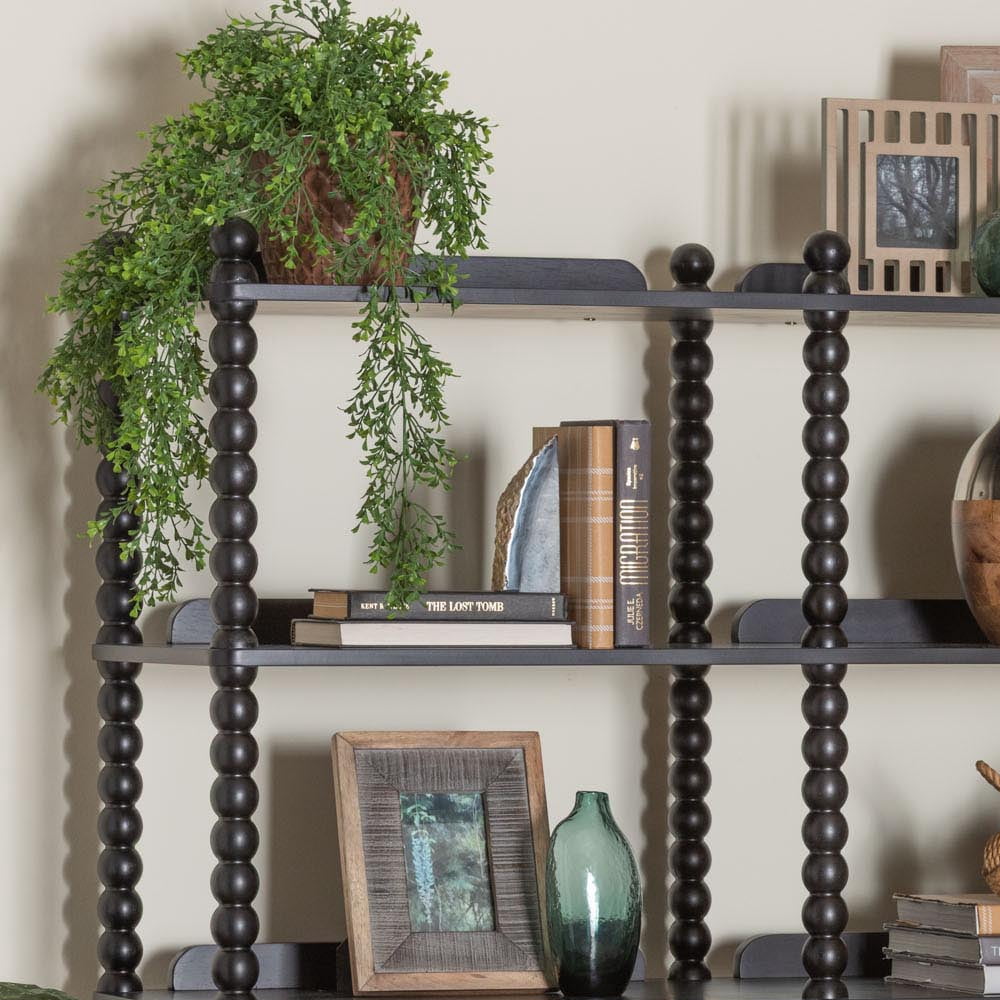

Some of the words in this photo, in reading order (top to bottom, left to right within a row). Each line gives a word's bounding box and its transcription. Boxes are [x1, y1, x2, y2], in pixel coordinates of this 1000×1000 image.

[619, 499, 649, 586] MIGRATION
[360, 602, 378, 610] KENT
[426, 601, 446, 612] THE
[449, 601, 474, 612] LOST
[475, 601, 504, 612] TOMB
